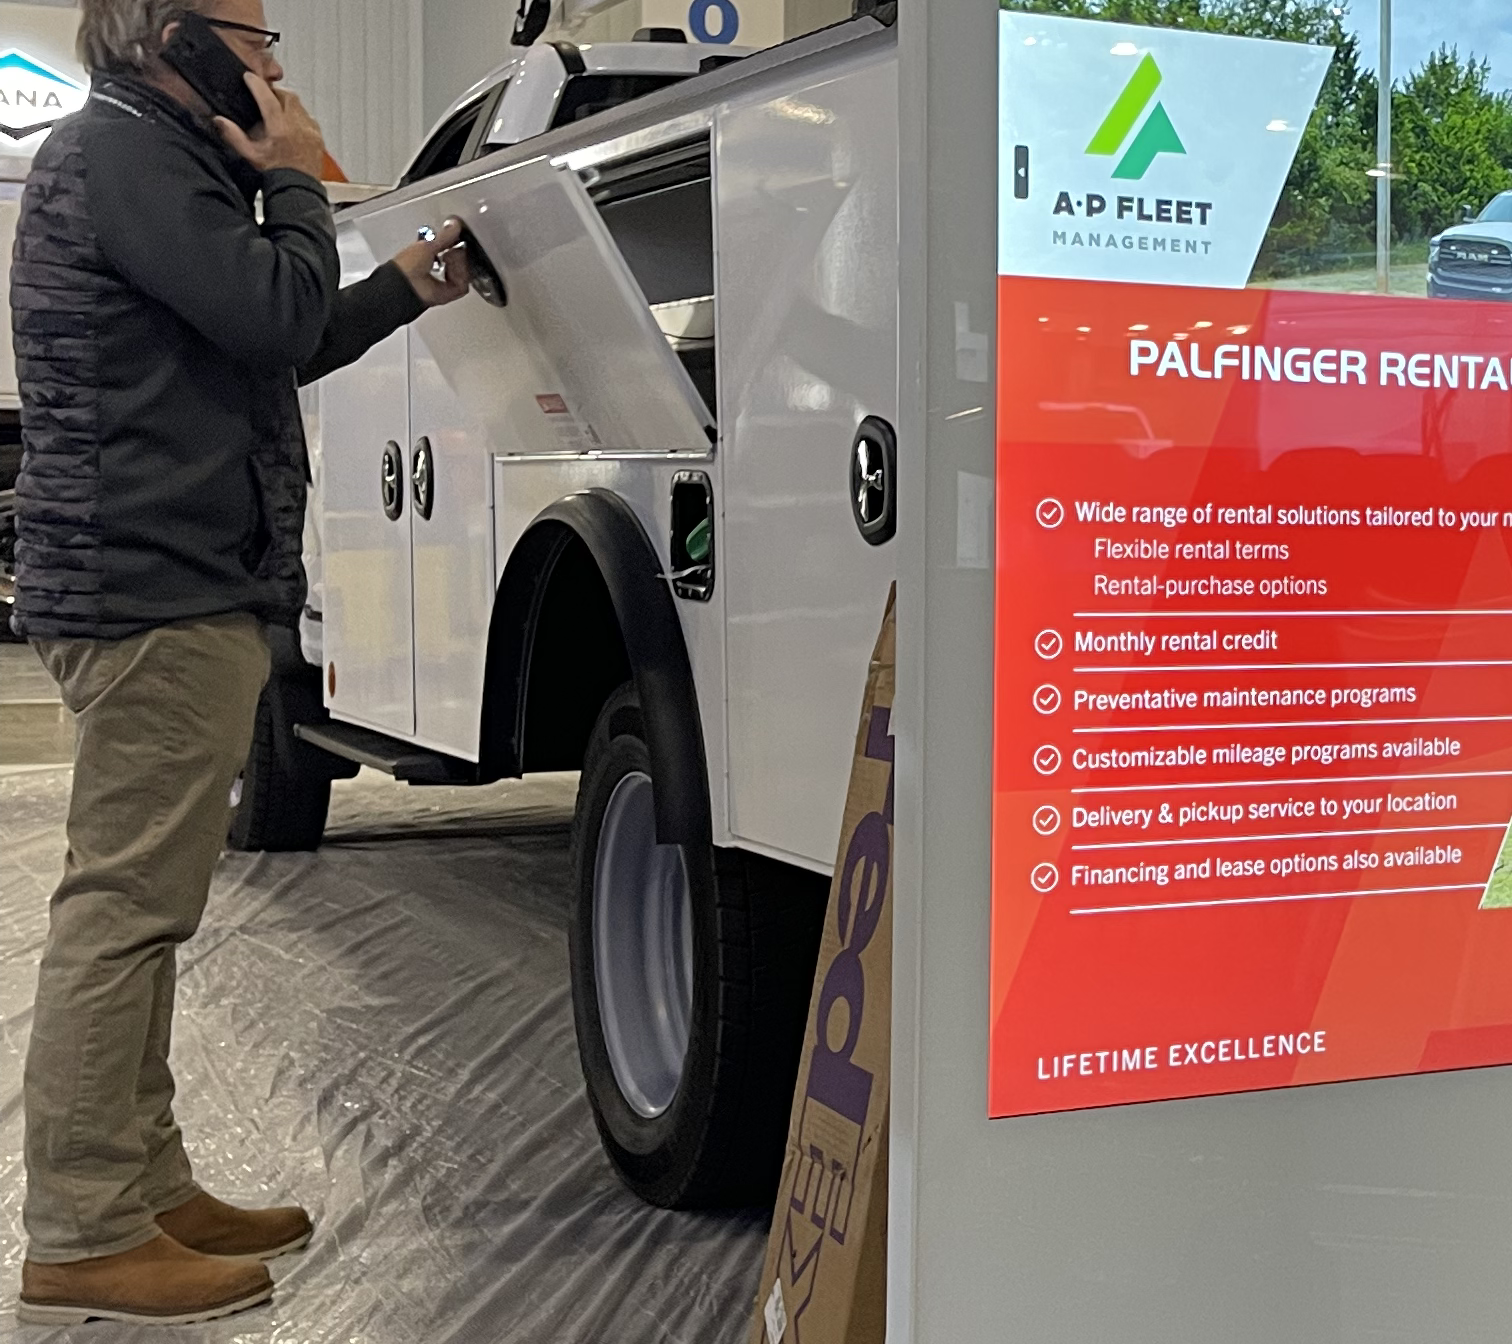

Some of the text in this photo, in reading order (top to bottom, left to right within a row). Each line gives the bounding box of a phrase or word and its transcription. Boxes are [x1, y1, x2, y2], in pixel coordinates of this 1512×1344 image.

[1116, 195, 1213, 225] FLEET
[1053, 230, 1212, 255] MANAGEMENT
[1129, 340, 1367, 385] PALFINGER
[1075, 501, 1127, 523] Wide
[1132, 506, 1188, 528] range
[1192, 503, 1213, 524] of
[1217, 504, 1272, 525] rental
[1277, 504, 1361, 526] solutions
[1365, 506, 1433, 527] tailored
[1438, 508, 1456, 527] to
[1459, 511, 1499, 532] your
[1094, 538, 1290, 560] Flexible rental terms
[1094, 574, 1328, 599] Rental-purchase options
[1075, 629, 1279, 656] Monthly rental credit
[1073, 686, 1417, 711] Preventative maintenance programs
[1072, 737, 1461, 770] Customizable mileage programs available
[1072, 791, 1457, 830] Delivery & pickup service to your location
[1071, 844, 1463, 886] Financing and lease options also available
[1037, 1030, 1327, 1080] LIFETIME EXCELLENCE
